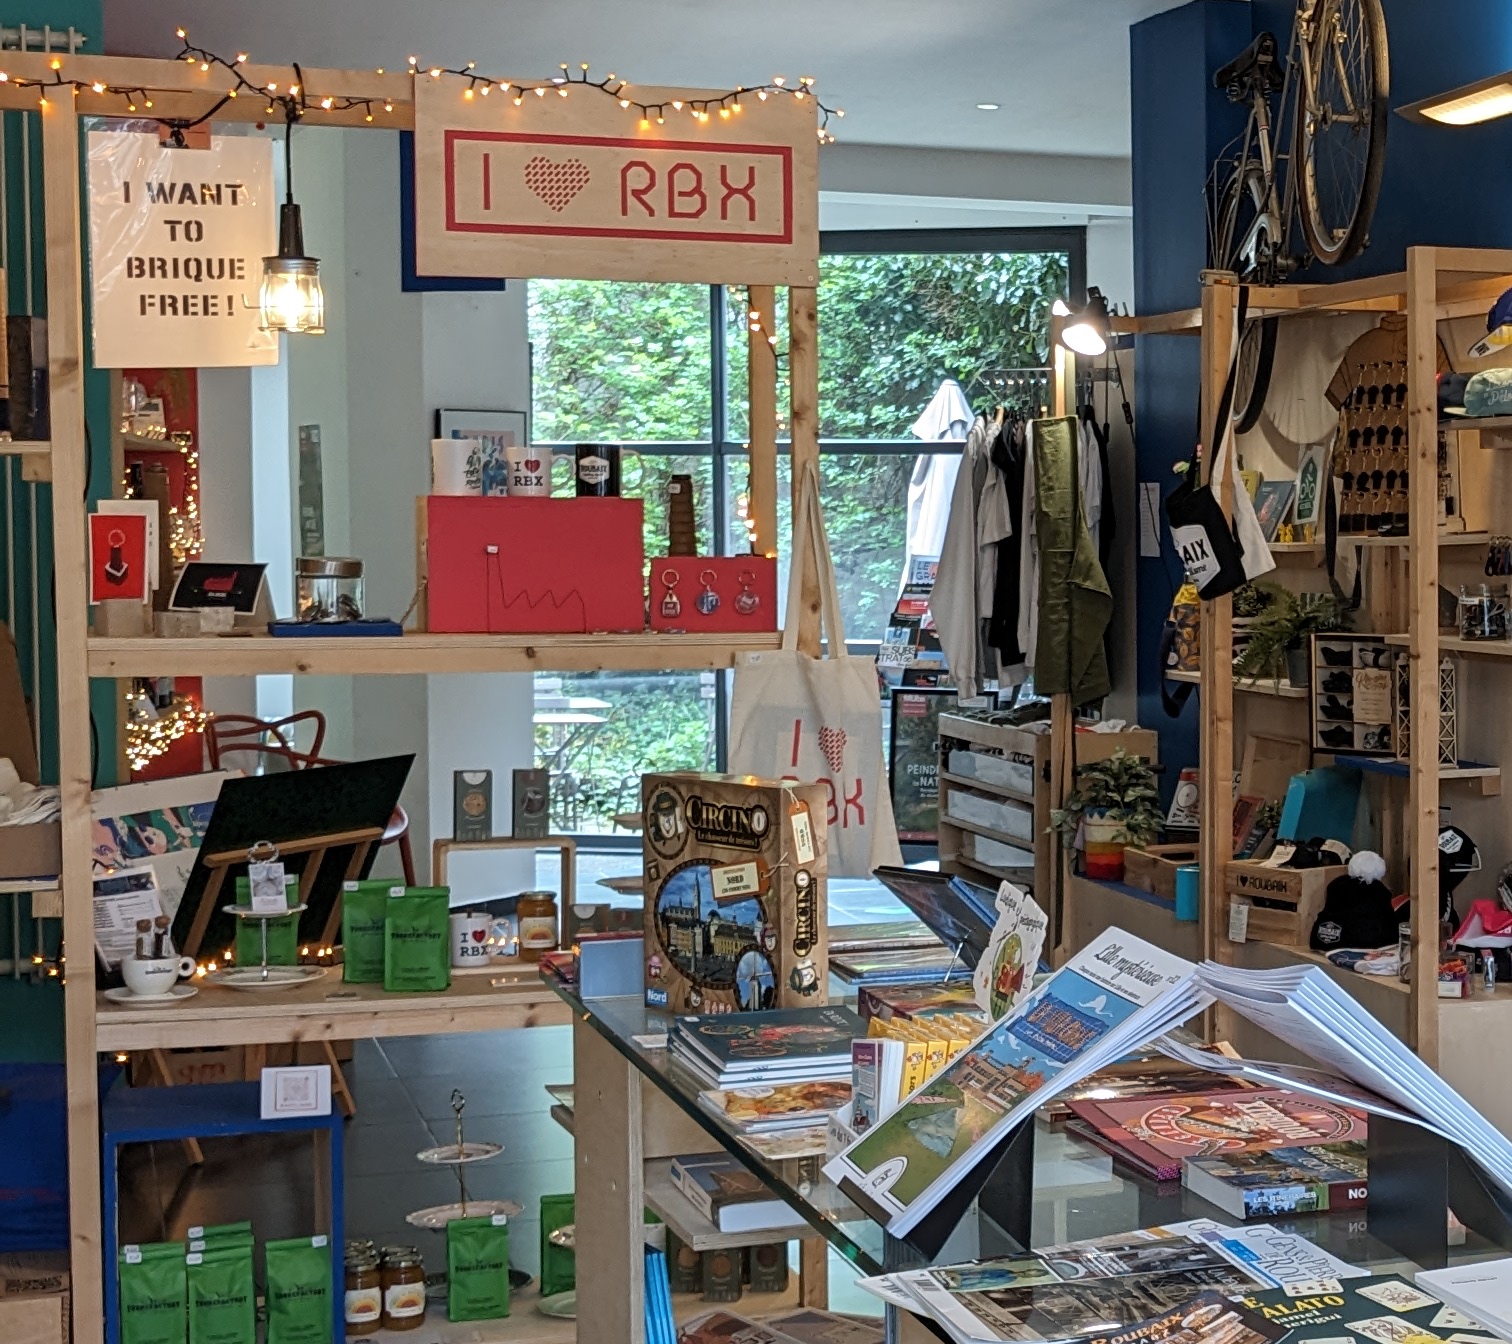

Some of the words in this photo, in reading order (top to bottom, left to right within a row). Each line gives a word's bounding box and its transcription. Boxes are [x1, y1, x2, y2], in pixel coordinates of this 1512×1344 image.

[123, 181, 131, 204] I
[146, 182, 244, 206] WANT
[483, 153, 491, 211] I
[620, 159, 756, 222] RBX
[164, 220, 204, 243] TO
[127, 256, 245, 283] BRIQUE
[140, 294, 234, 317] FREE!
[514, 475, 544, 487] RBX
[1182, 538, 1210, 566] AIX
[686, 796, 770, 836] CIRCINO
[794, 869, 812, 958] CIRCINO
[646, 988, 667, 1004] Nord
[1348, 1188, 1368, 1200] NO
[1257, 1255, 1312, 1284] ROU
[1261, 1294, 1346, 1320] ALATO
